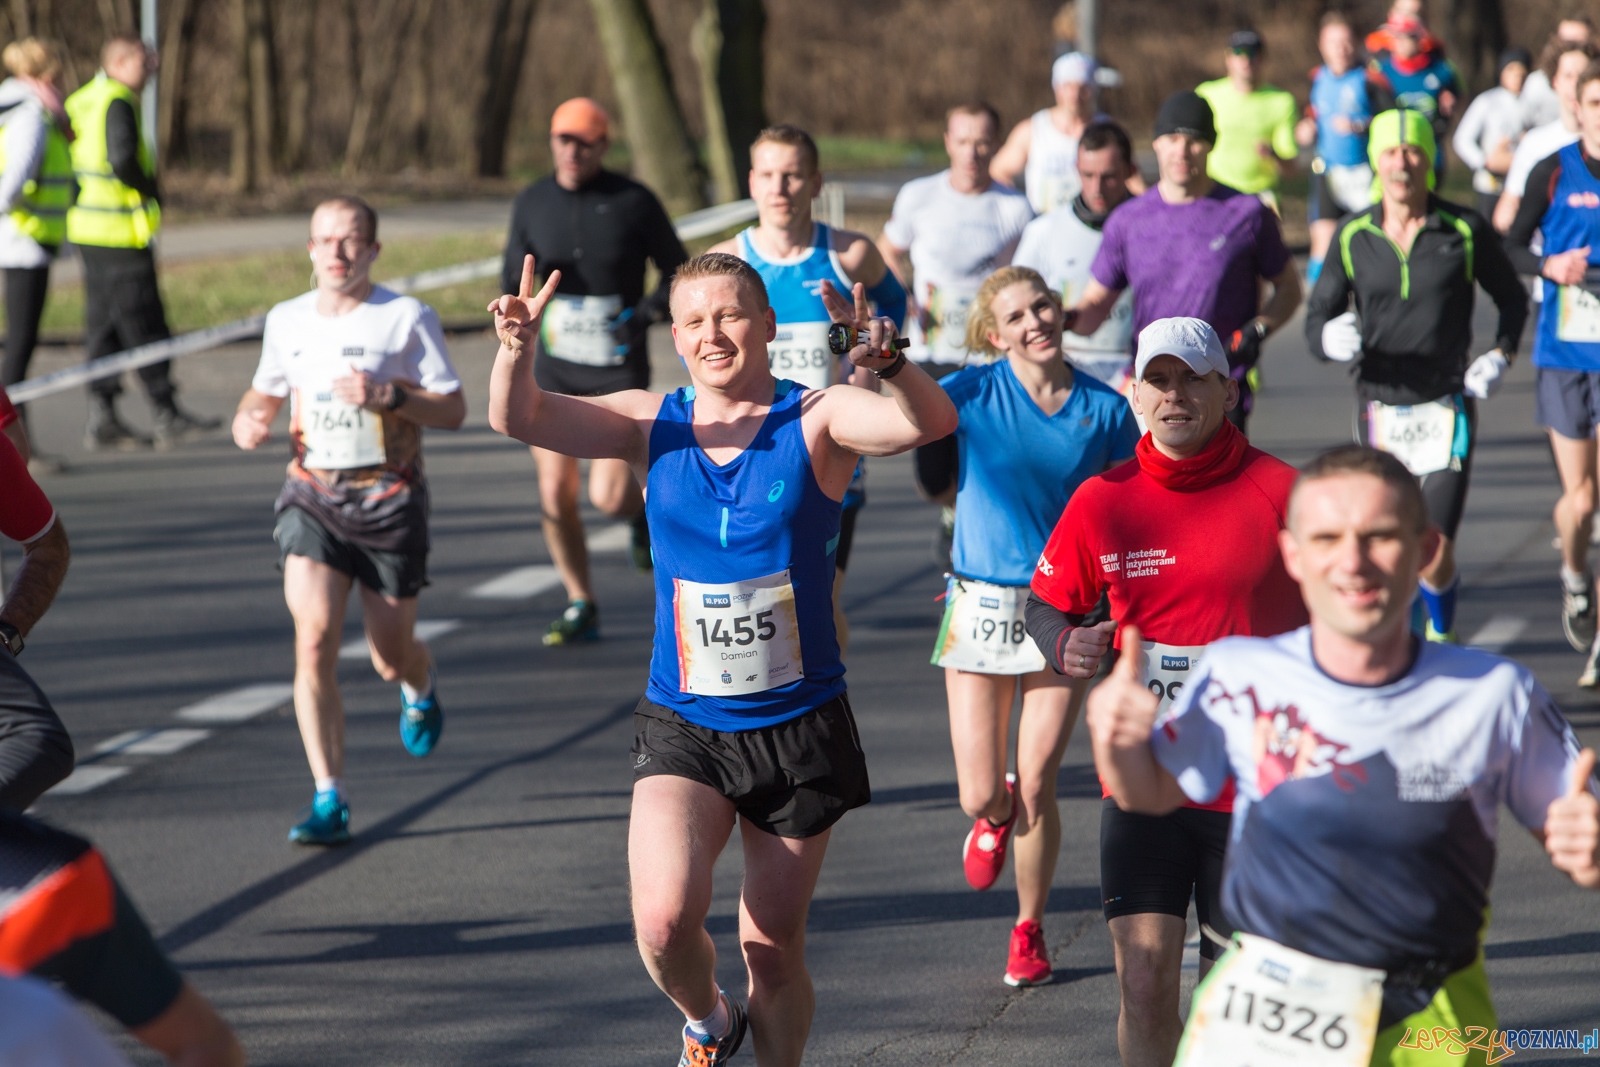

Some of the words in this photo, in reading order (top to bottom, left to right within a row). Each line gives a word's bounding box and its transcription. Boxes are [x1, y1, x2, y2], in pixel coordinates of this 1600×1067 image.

[1100, 553, 1118, 564] TEAM
[1126, 549, 1167, 559] Jesteśmy
[1126, 556, 1176, 570] inżynierami
[1126, 568, 1159, 578] światła
[705, 597, 729, 605] 10.PKO
[696, 610, 776, 647] 1455
[721, 650, 758, 660] Damian
[1222, 985, 1348, 1049] 11326
